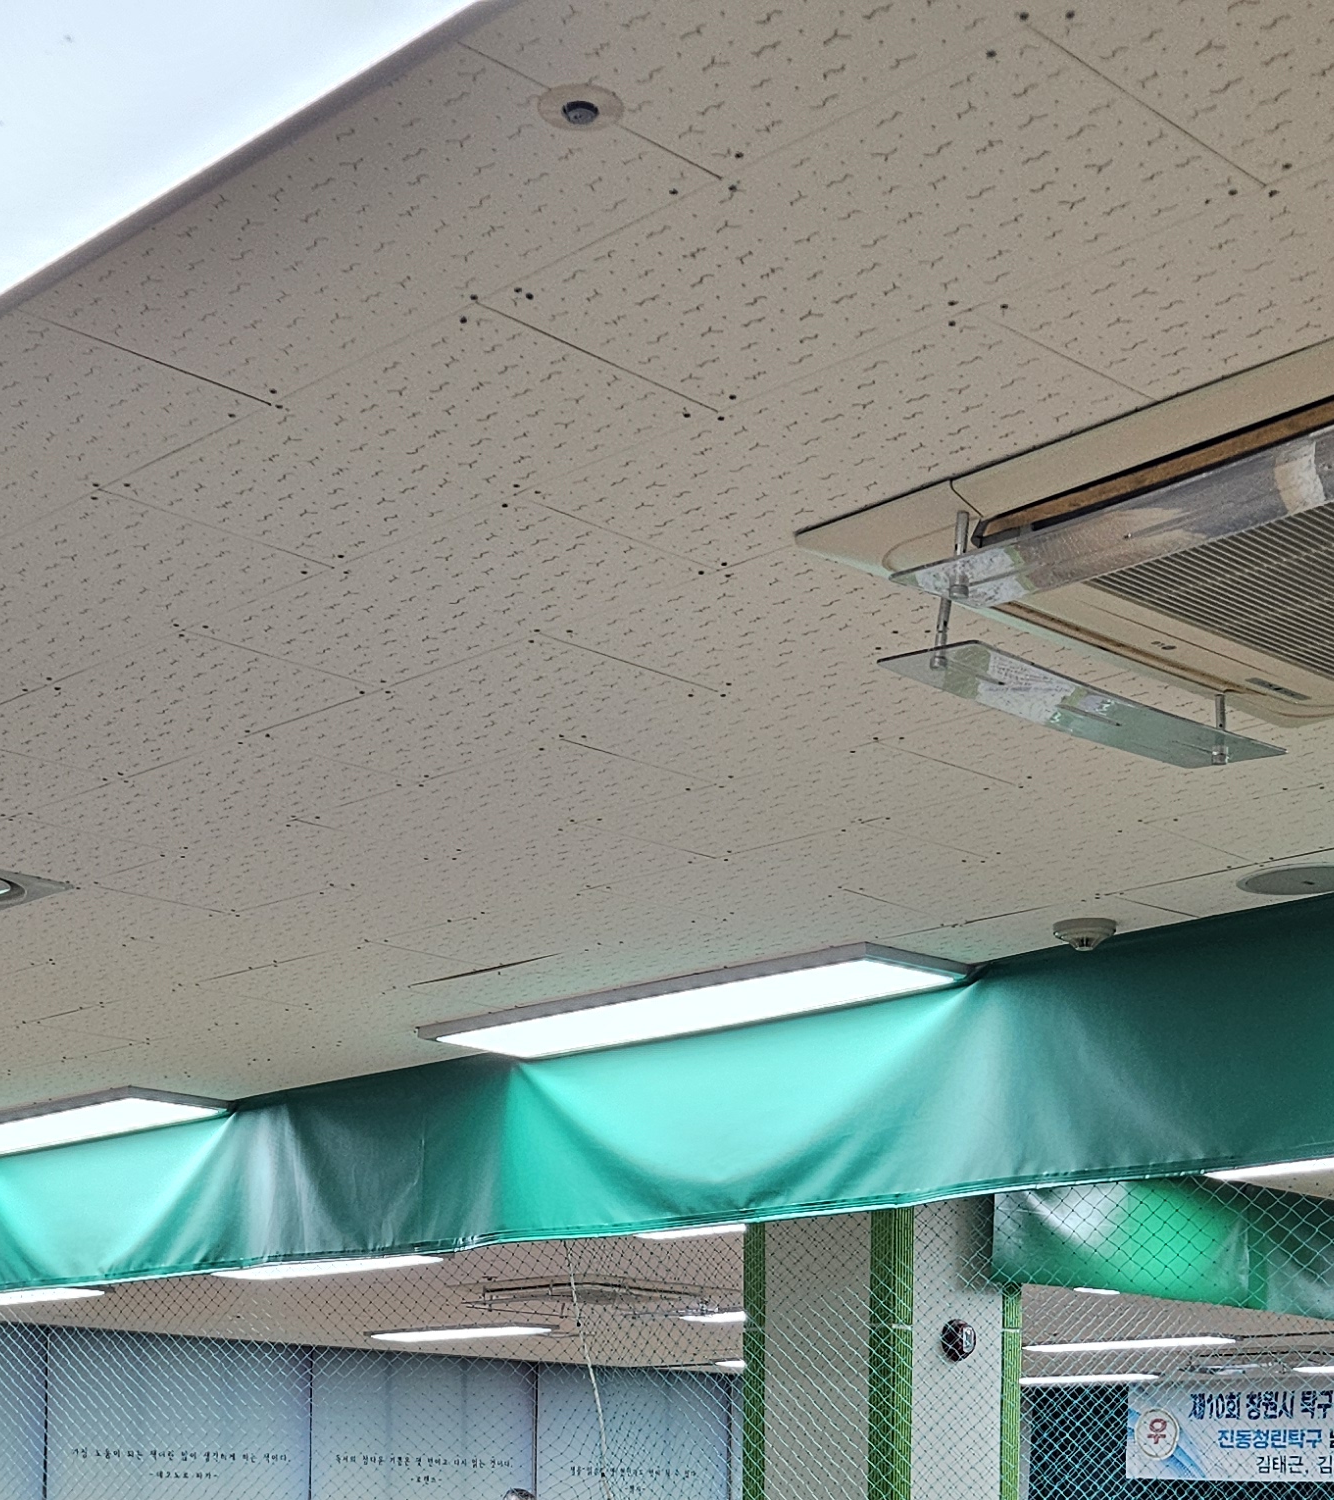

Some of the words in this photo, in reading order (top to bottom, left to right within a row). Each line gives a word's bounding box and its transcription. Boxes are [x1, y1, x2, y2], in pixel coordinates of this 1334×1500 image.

[1188, 1391, 1241, 1420] 제10회
[1147, 1418, 1166, 1444] 우
[1256, 1455, 1309, 1475] 김태근,
